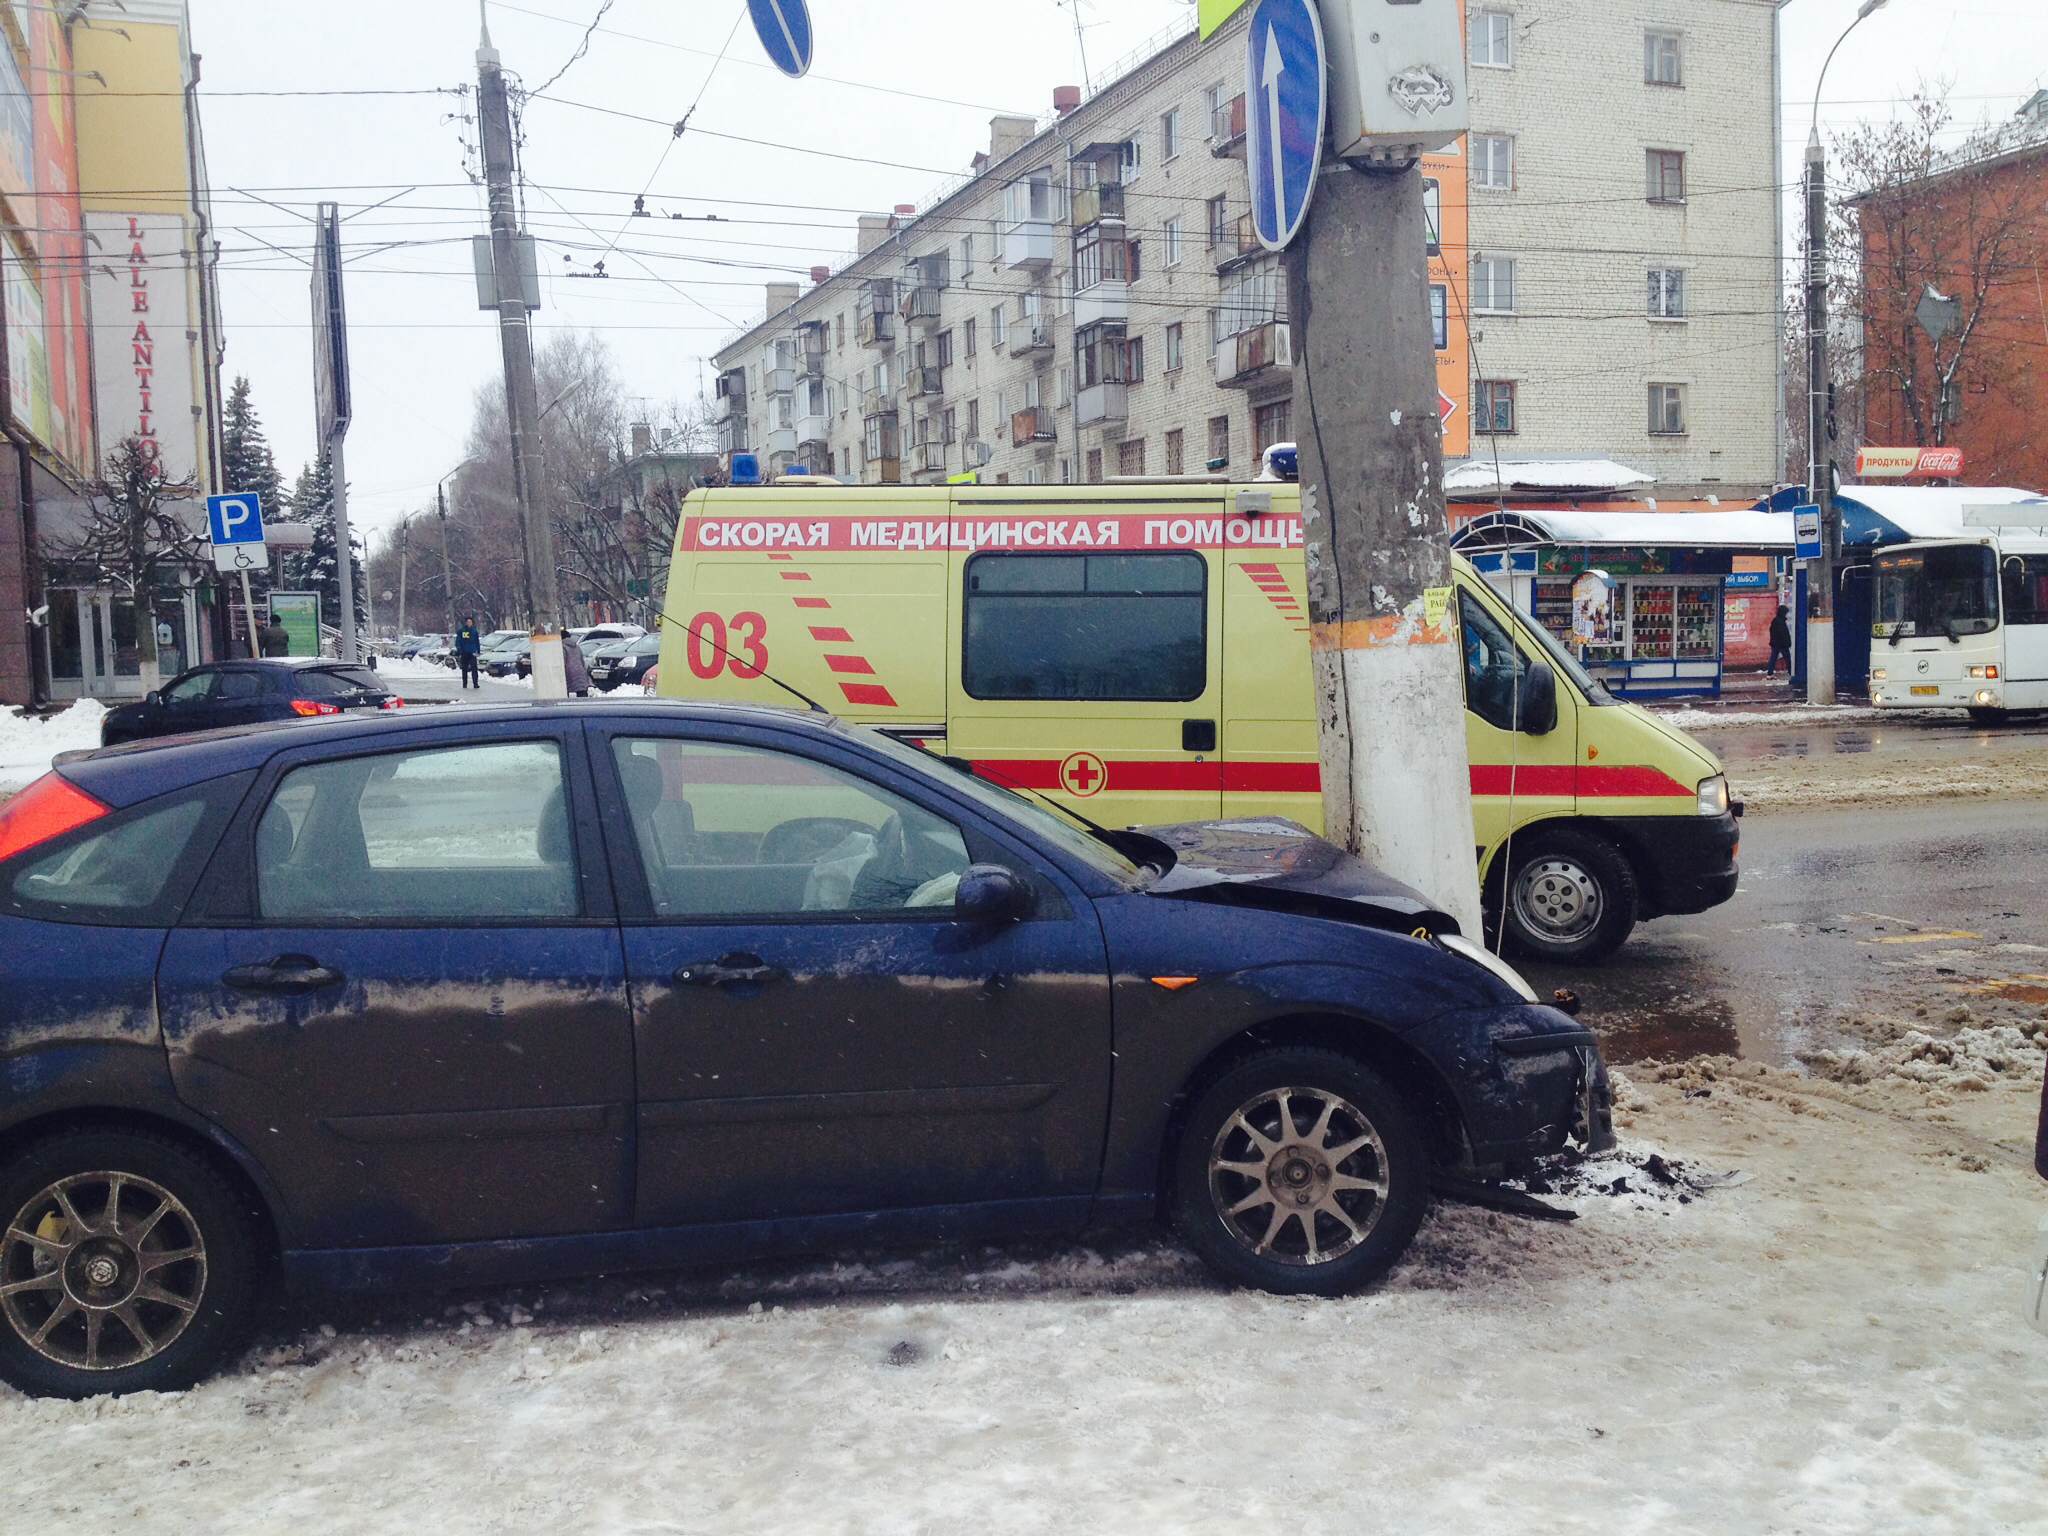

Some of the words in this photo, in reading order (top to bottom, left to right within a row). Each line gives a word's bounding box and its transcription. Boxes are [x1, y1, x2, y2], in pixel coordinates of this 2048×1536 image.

[127, 217, 149, 313] LALE
[1866, 457, 1912, 467] ПРОДУКТЫ
[219, 499, 250, 539] P
[699, 521, 830, 548] СКОРАЯ
[849, 520, 1120, 551] МЕДИЦИНСКАЯ
[686, 611, 769, 680] 03
